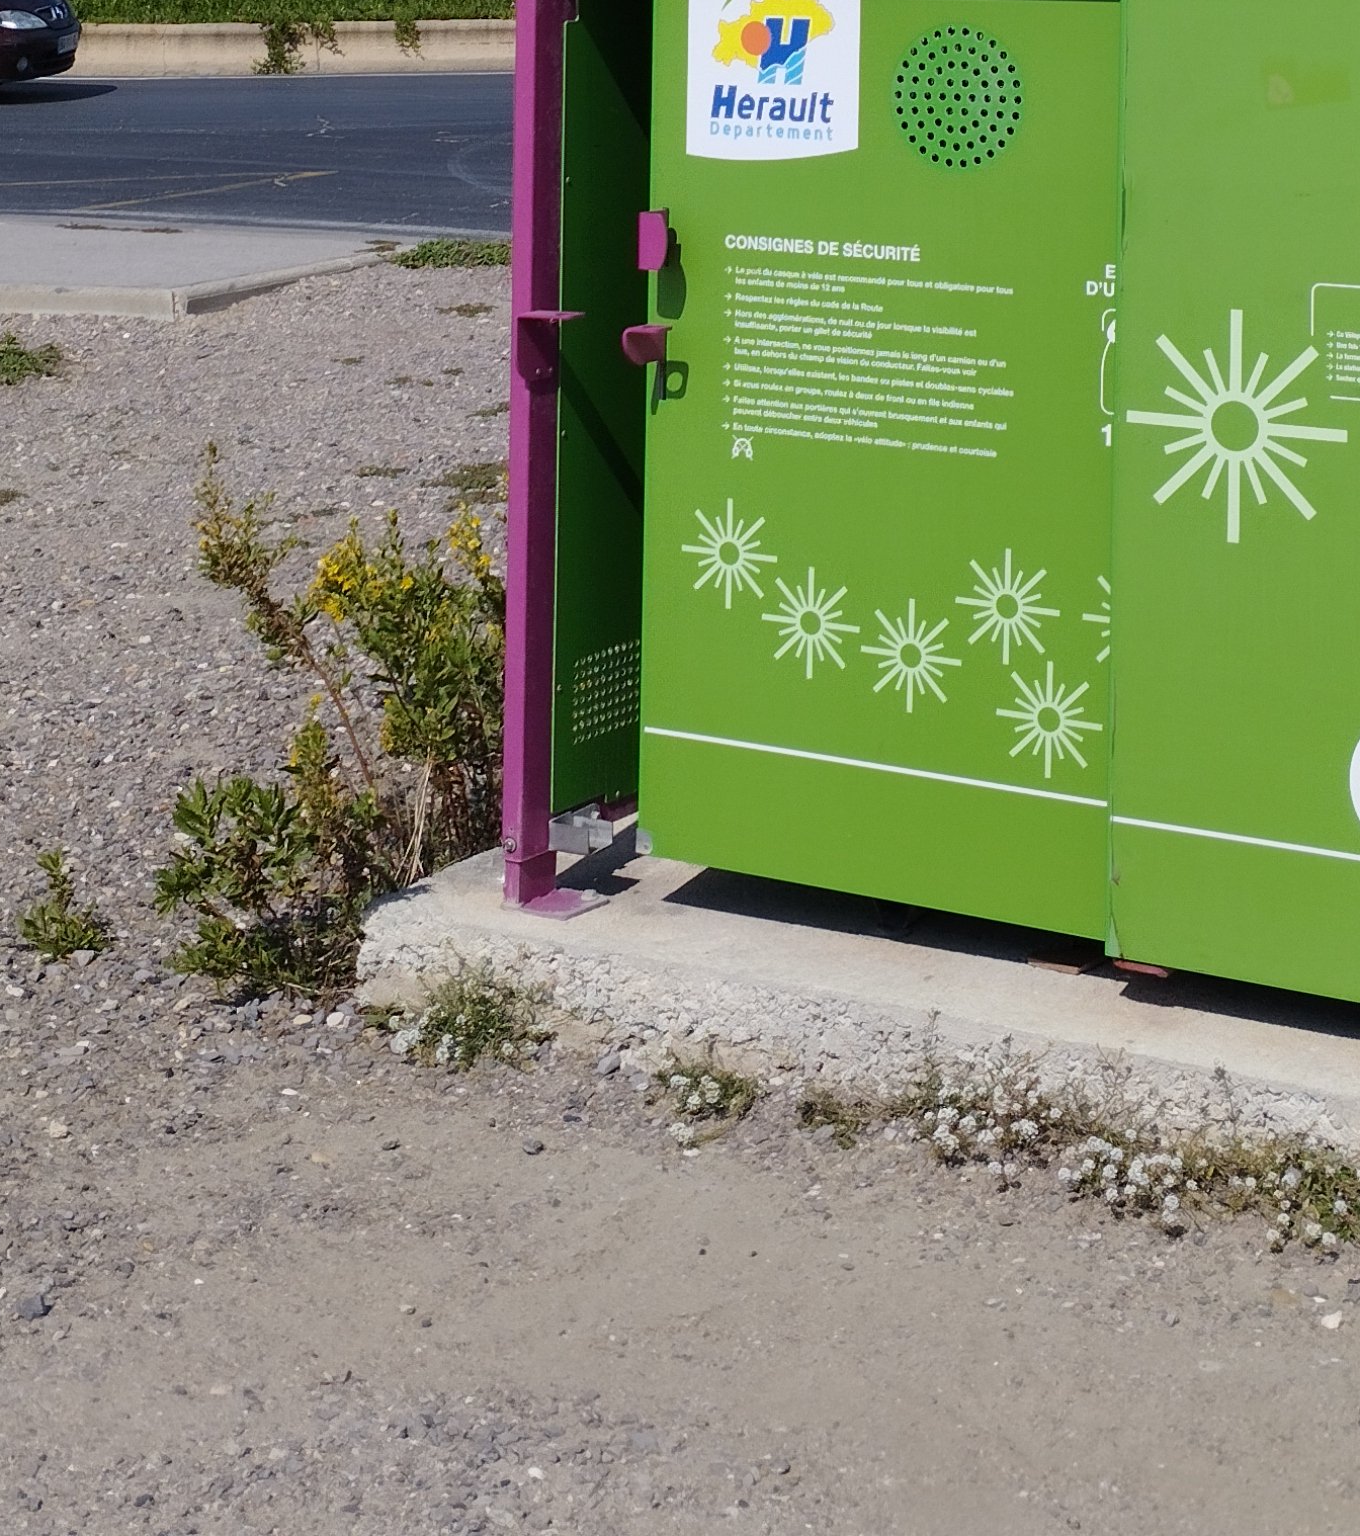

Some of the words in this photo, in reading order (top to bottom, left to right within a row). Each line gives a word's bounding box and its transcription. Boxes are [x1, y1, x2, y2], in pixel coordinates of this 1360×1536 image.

[725, 234, 814, 254] CONSIGNES
[817, 241, 839, 256] DE
[843, 240, 921, 262] SÉCURITÉ
